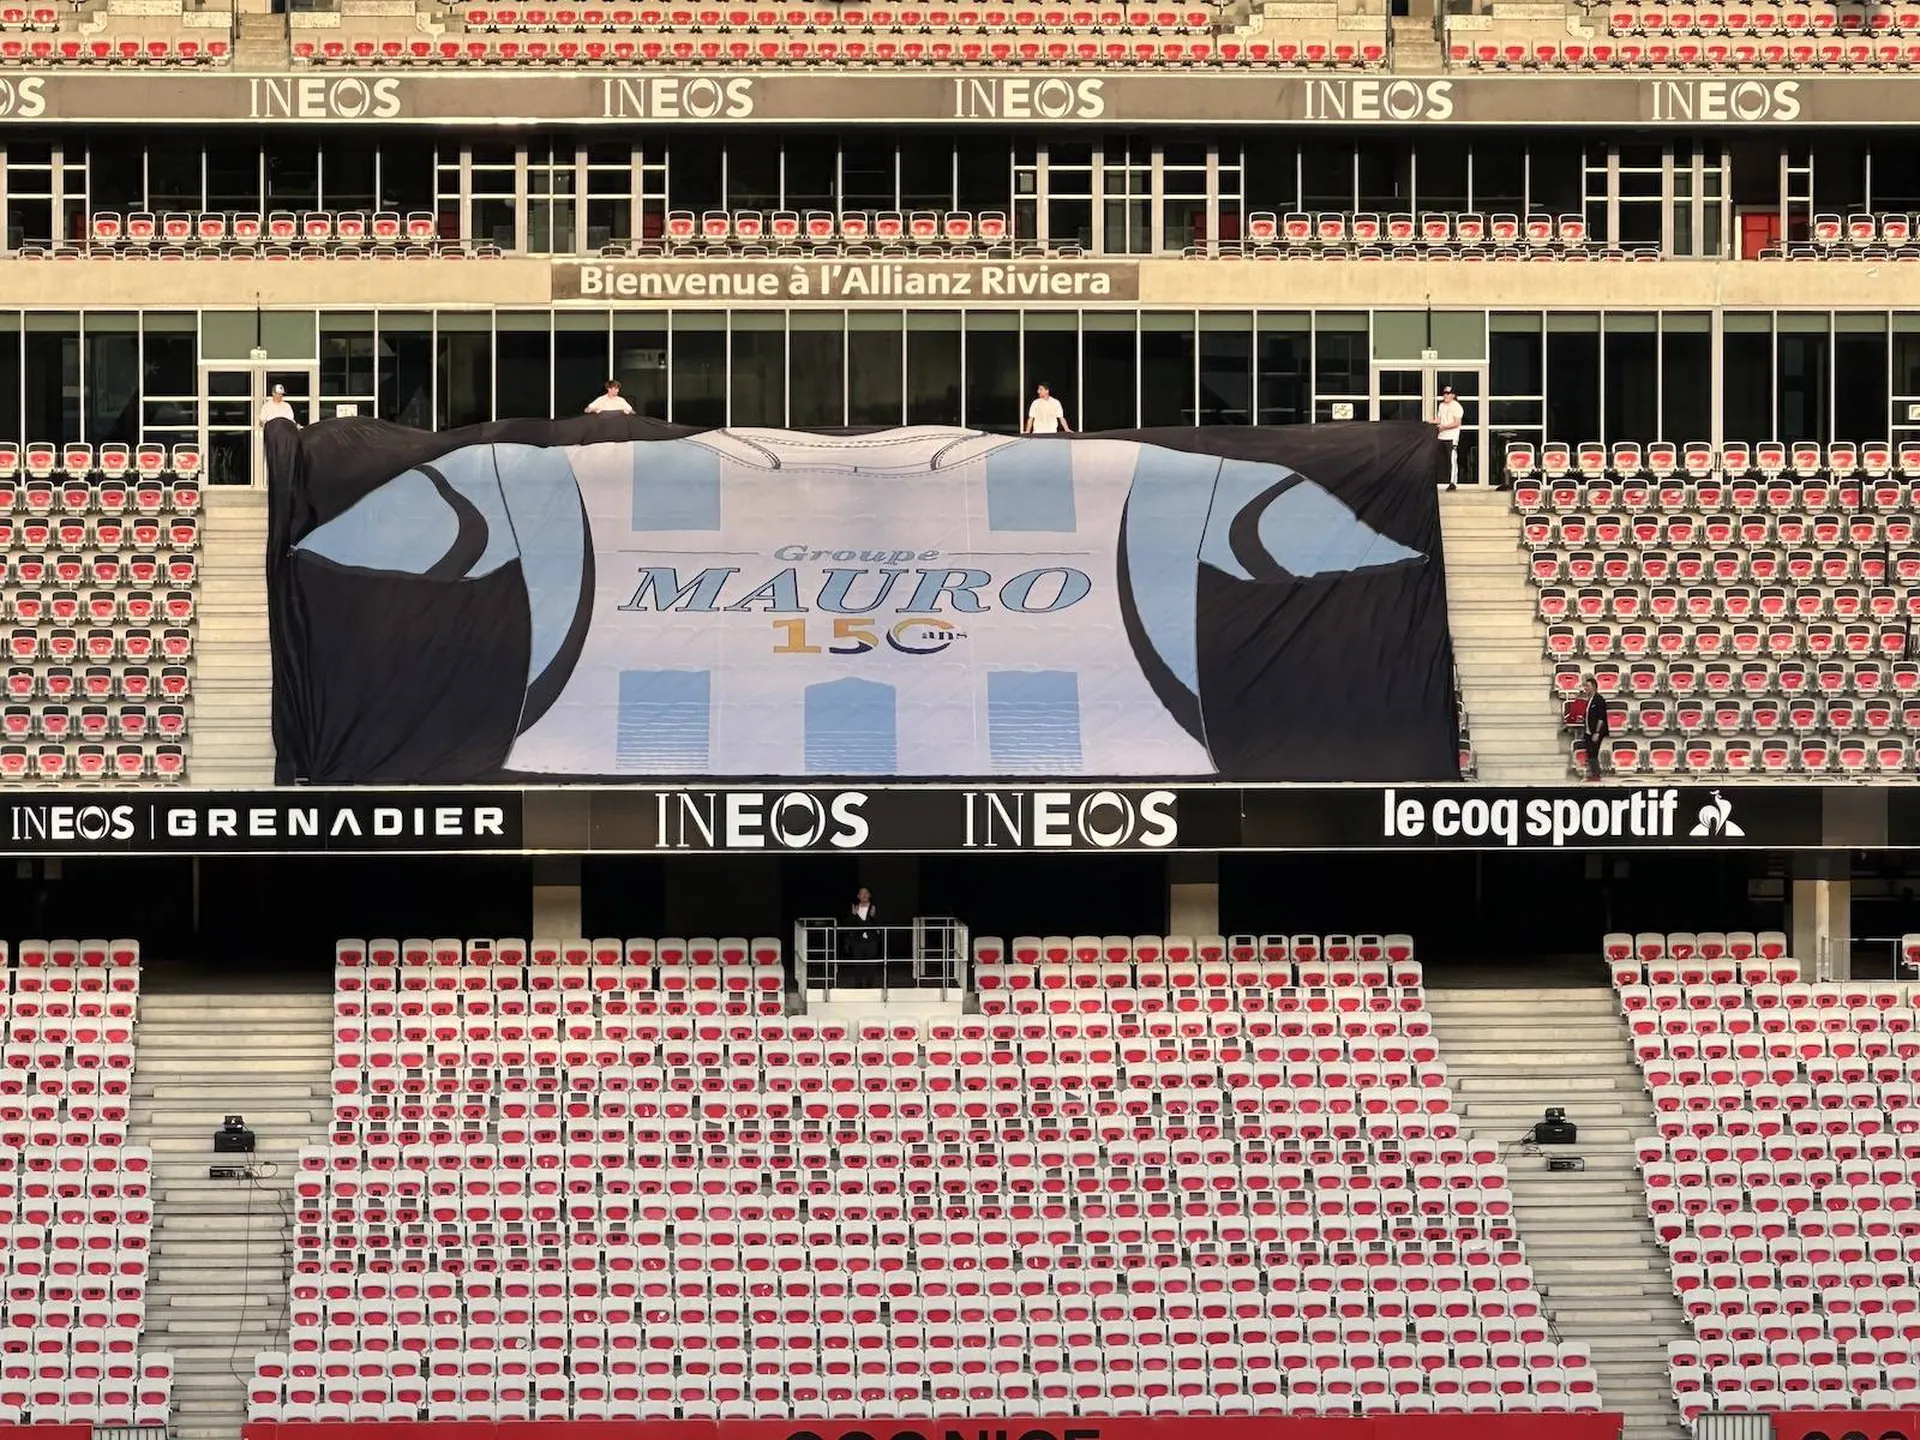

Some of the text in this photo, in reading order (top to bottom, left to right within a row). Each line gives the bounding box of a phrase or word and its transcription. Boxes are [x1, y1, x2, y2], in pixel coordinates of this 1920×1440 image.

[249, 77, 401, 118] INEOS
[602, 77, 755, 118] INEOS
[954, 77, 1105, 118] INEOS
[1304, 80, 1454, 119] INEOS
[1651, 80, 1801, 119] INEOS
[580, 265, 780, 296] Bienvenue
[788, 265, 810, 296] à
[981, 264, 1111, 296] Riviera
[774, 545, 940, 566] Groupe
[617, 567, 1092, 614] MAURO
[921, 627, 968, 641] ans
[11, 805, 504, 840] INEOS GRENADIER
[655, 791, 869, 848] INEOS
[962, 790, 1178, 847] INEOS
[1384, 788, 1678, 847] le coq sportif
